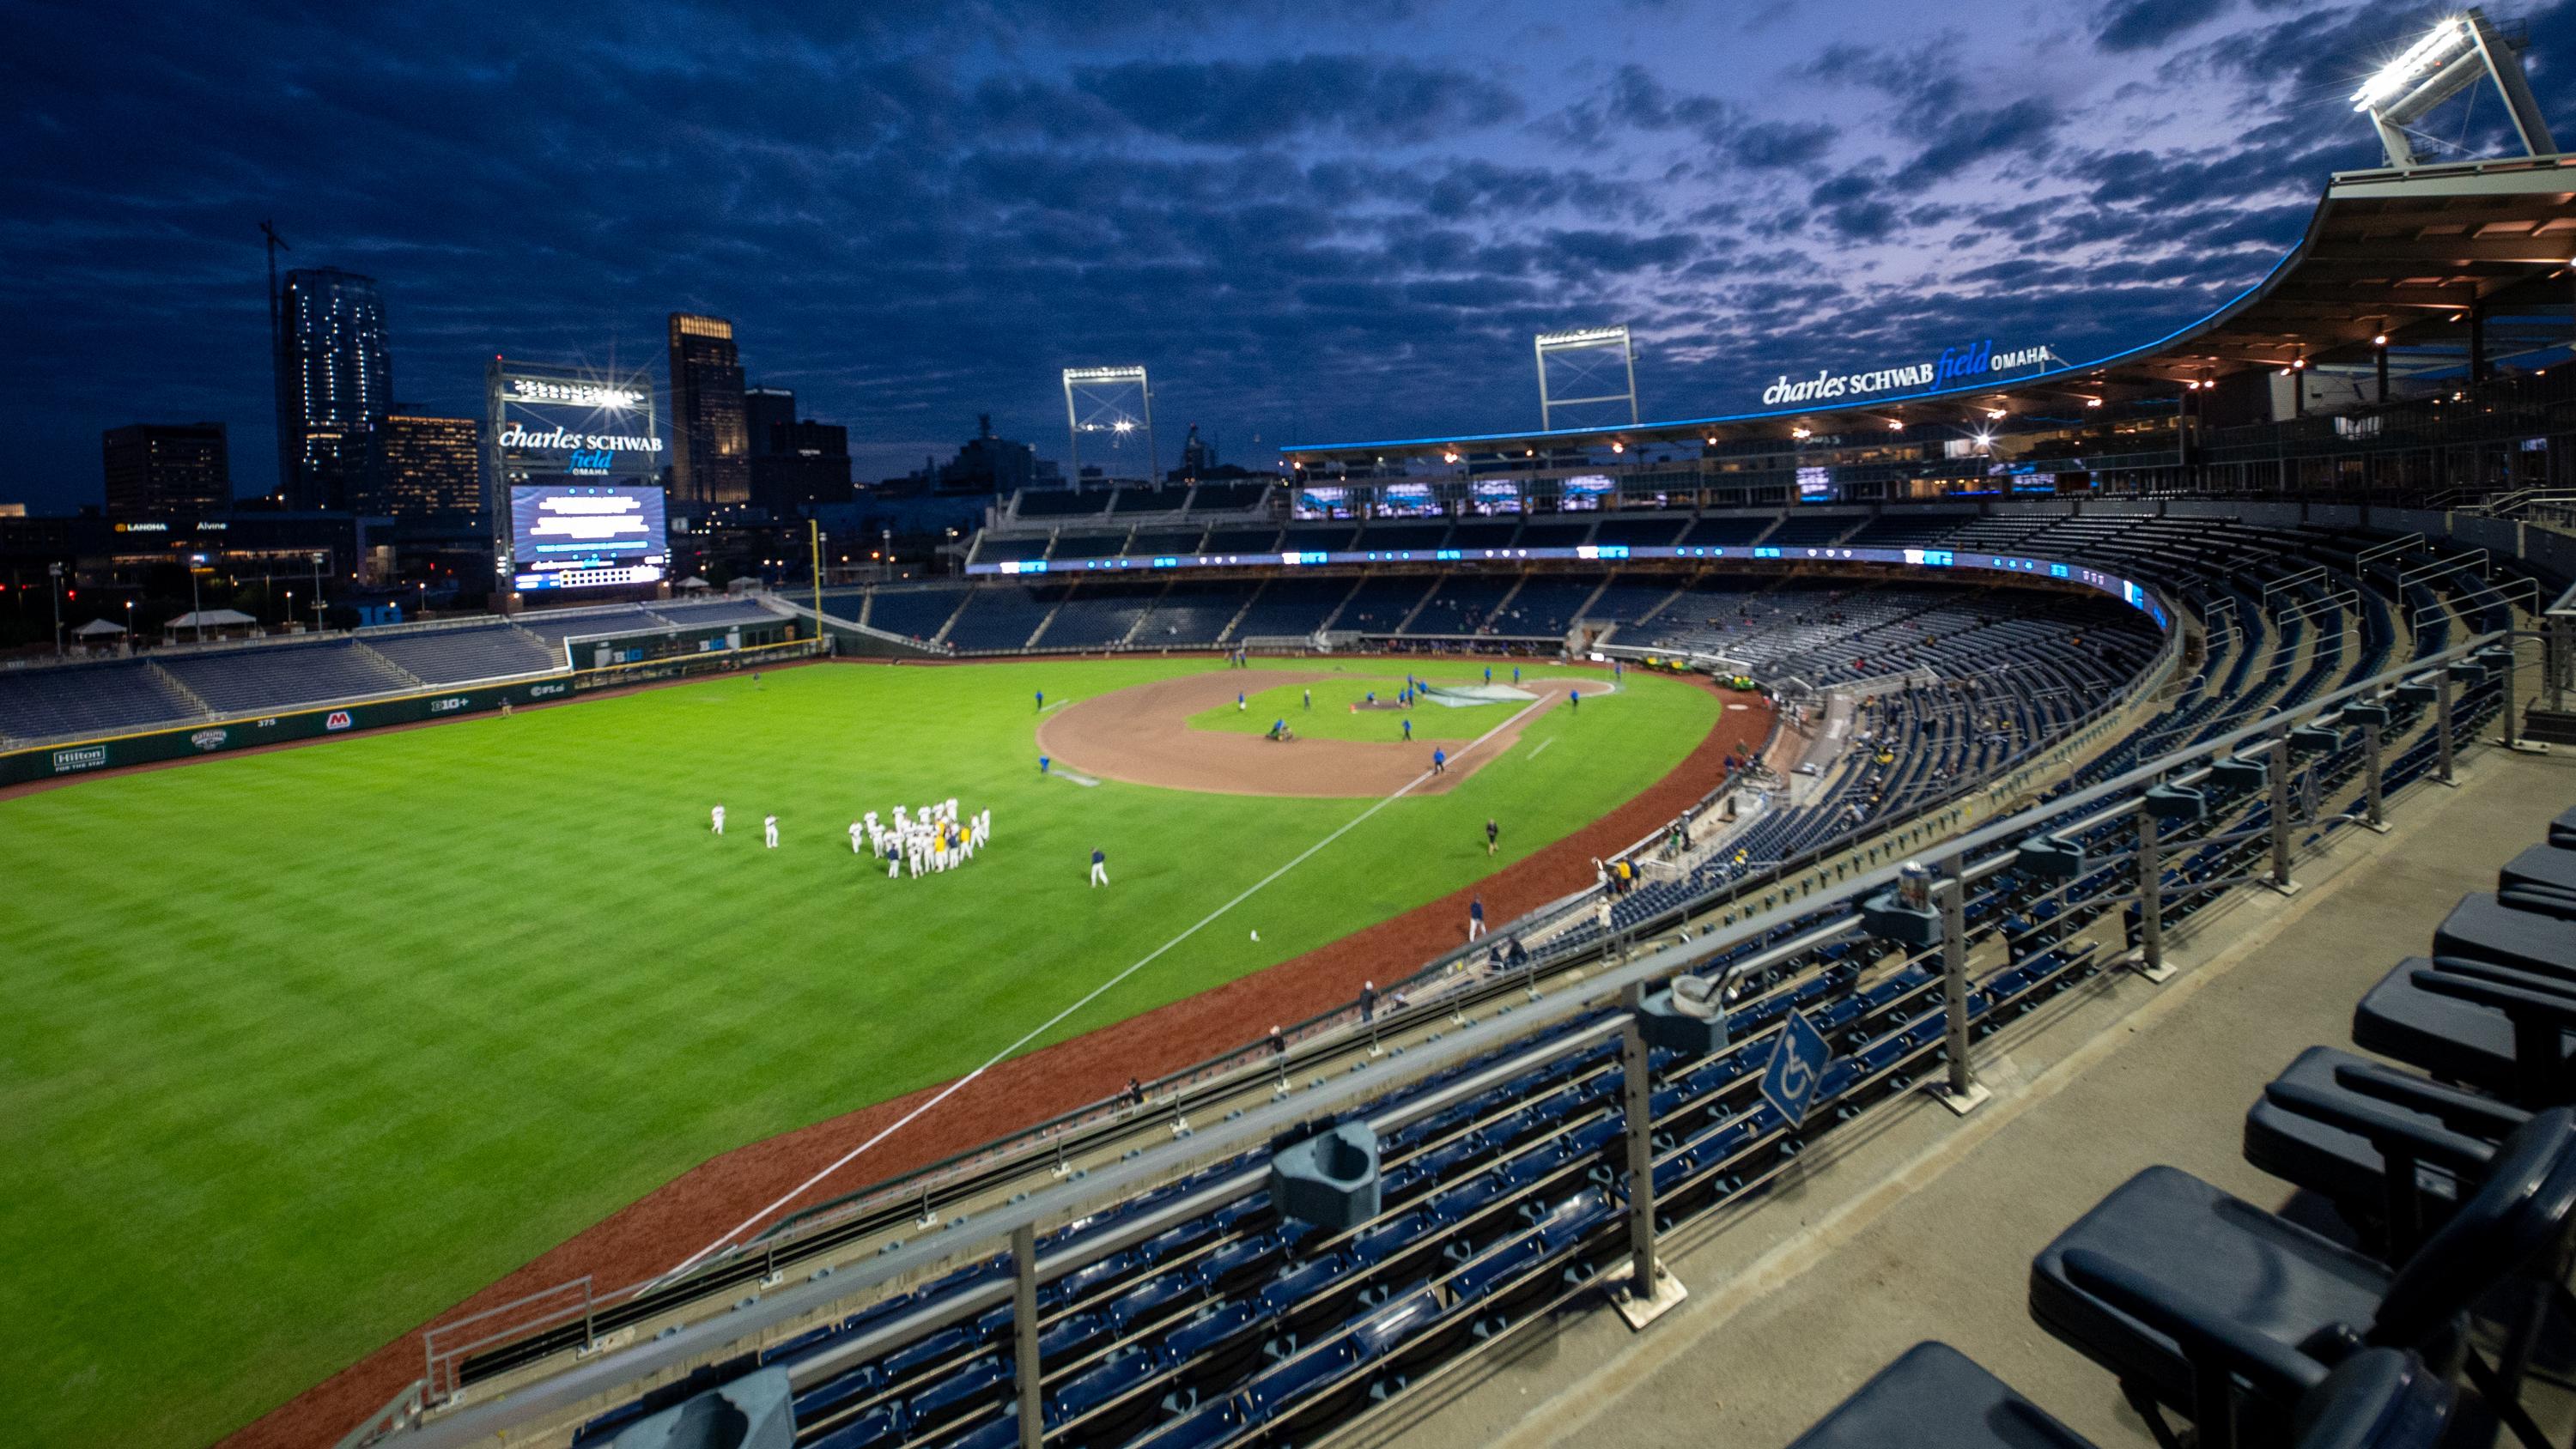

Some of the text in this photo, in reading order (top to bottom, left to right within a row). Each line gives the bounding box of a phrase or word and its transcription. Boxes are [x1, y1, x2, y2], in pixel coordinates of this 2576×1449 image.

[1763, 340, 2049, 405] charles SCHWAB field OMAHA
[499, 424, 663, 452] charles SCHWAB
[563, 449, 613, 473] field
[258, 718, 276, 727] 375
[58, 750, 100, 763] Hilton
